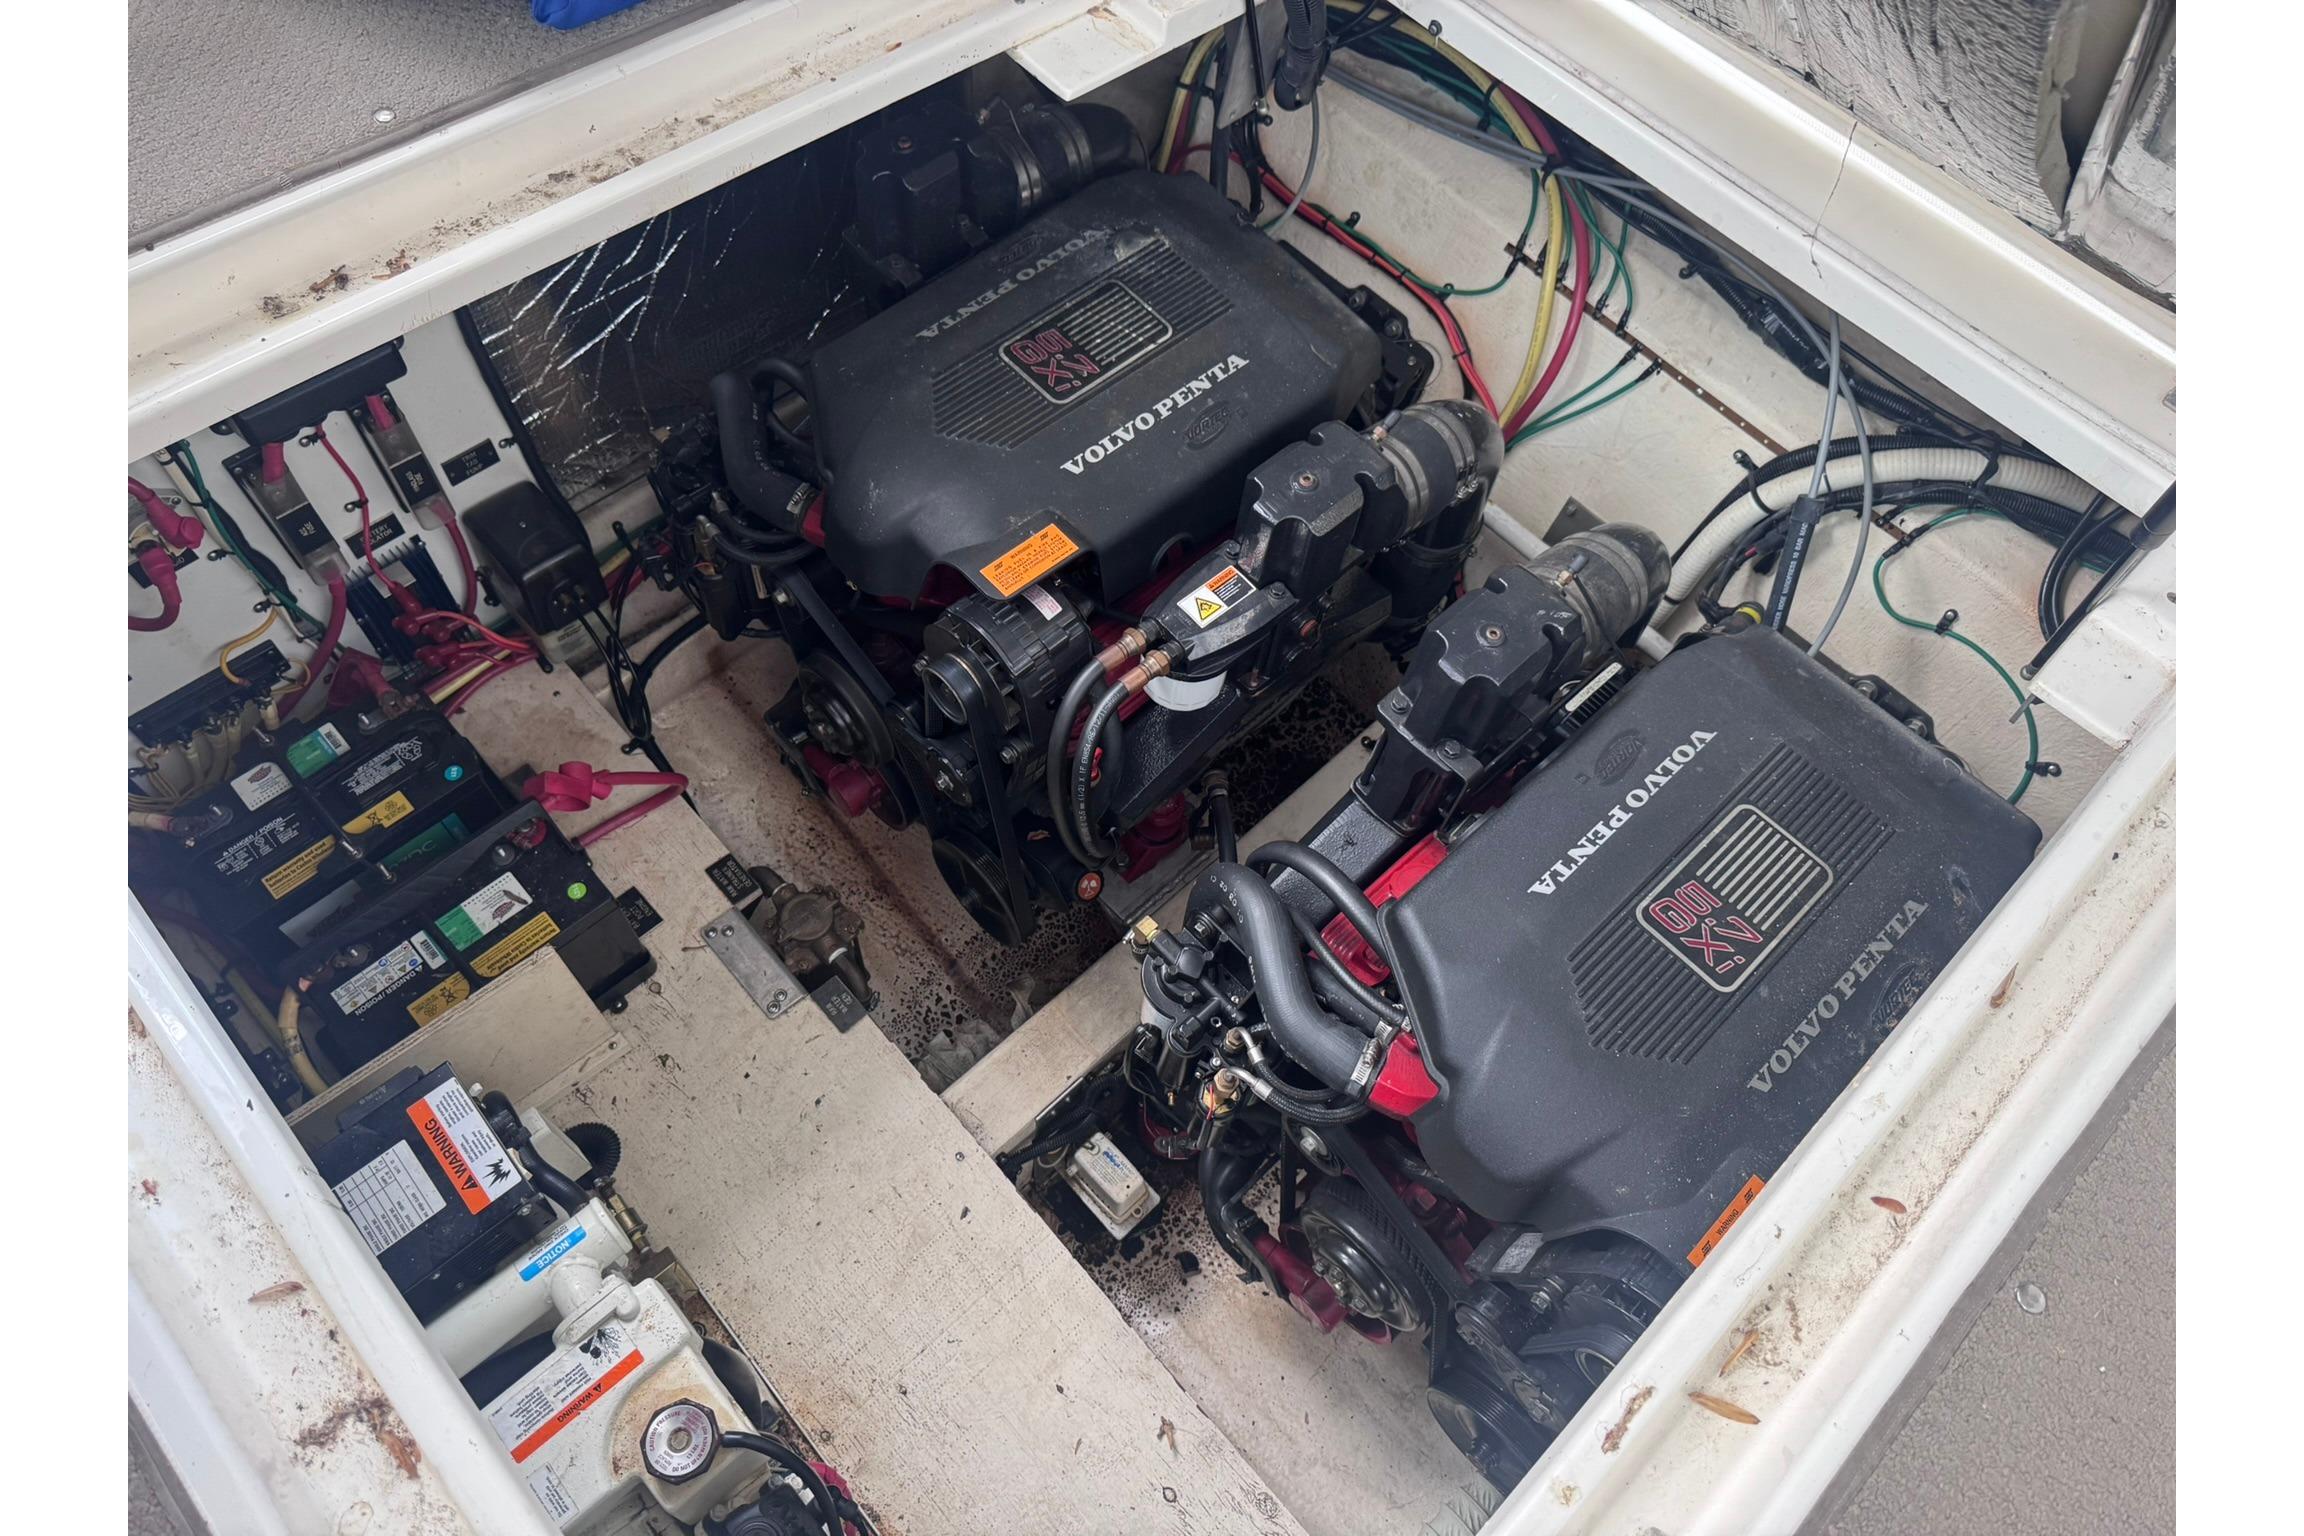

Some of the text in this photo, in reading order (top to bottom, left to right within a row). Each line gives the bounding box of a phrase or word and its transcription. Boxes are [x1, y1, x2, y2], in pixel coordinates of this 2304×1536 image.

[1014, 221, 1107, 285] VOLVO
[914, 275, 1017, 345] PENTA
[1060, 347, 1249, 481] VOLVO PENTA
[1525, 720, 1719, 904] VOLVO PENTA
[384, 969, 416, 993] DANGER
[1742, 893, 1930, 1099] VOLVO PENTA
[422, 1116, 468, 1179] WARNING
[1714, 1207, 1740, 1236] WARNING
[534, 1238, 571, 1269] NOTICE
[555, 1390, 594, 1423] WARNING
